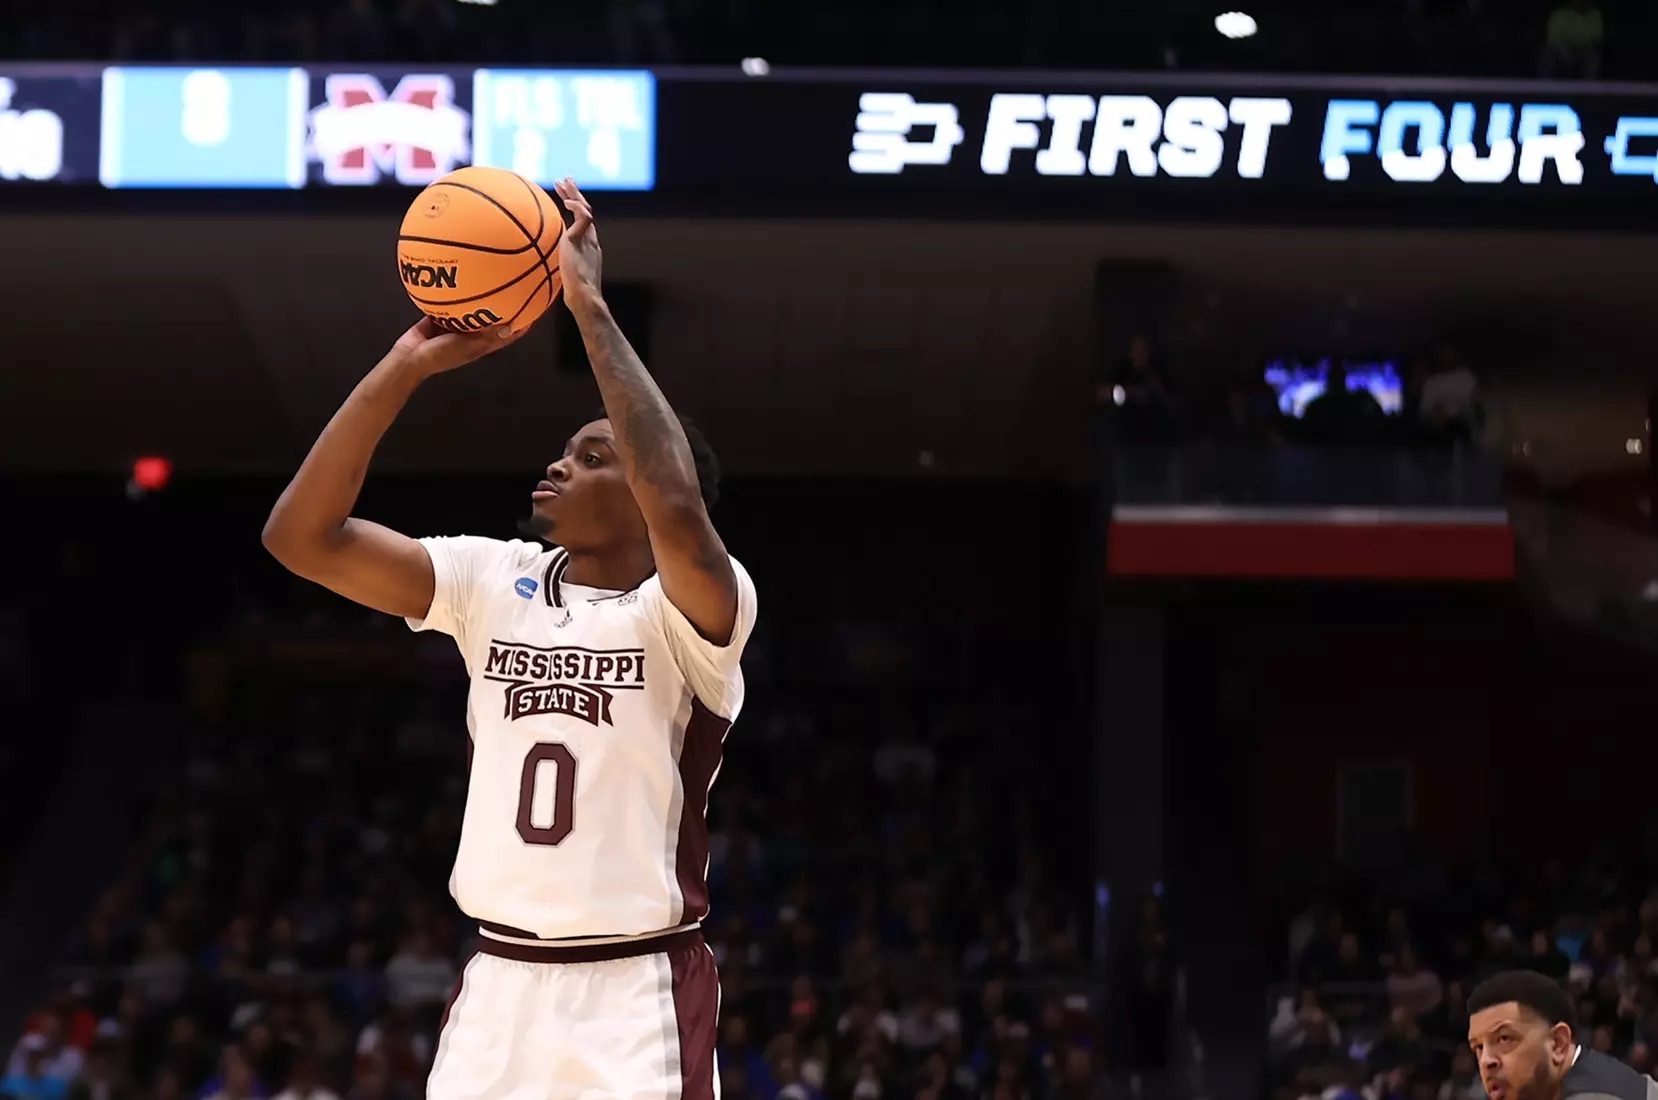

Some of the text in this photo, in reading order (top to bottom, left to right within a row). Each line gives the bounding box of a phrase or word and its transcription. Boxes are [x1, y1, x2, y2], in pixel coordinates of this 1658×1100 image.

[981, 92, 1586, 185] FIRST FOUR
[400, 259, 458, 289] NCAA
[484, 646, 646, 683] MISSISSIPPI
[517, 687, 590, 718] STATE
[514, 741, 579, 847] 0
